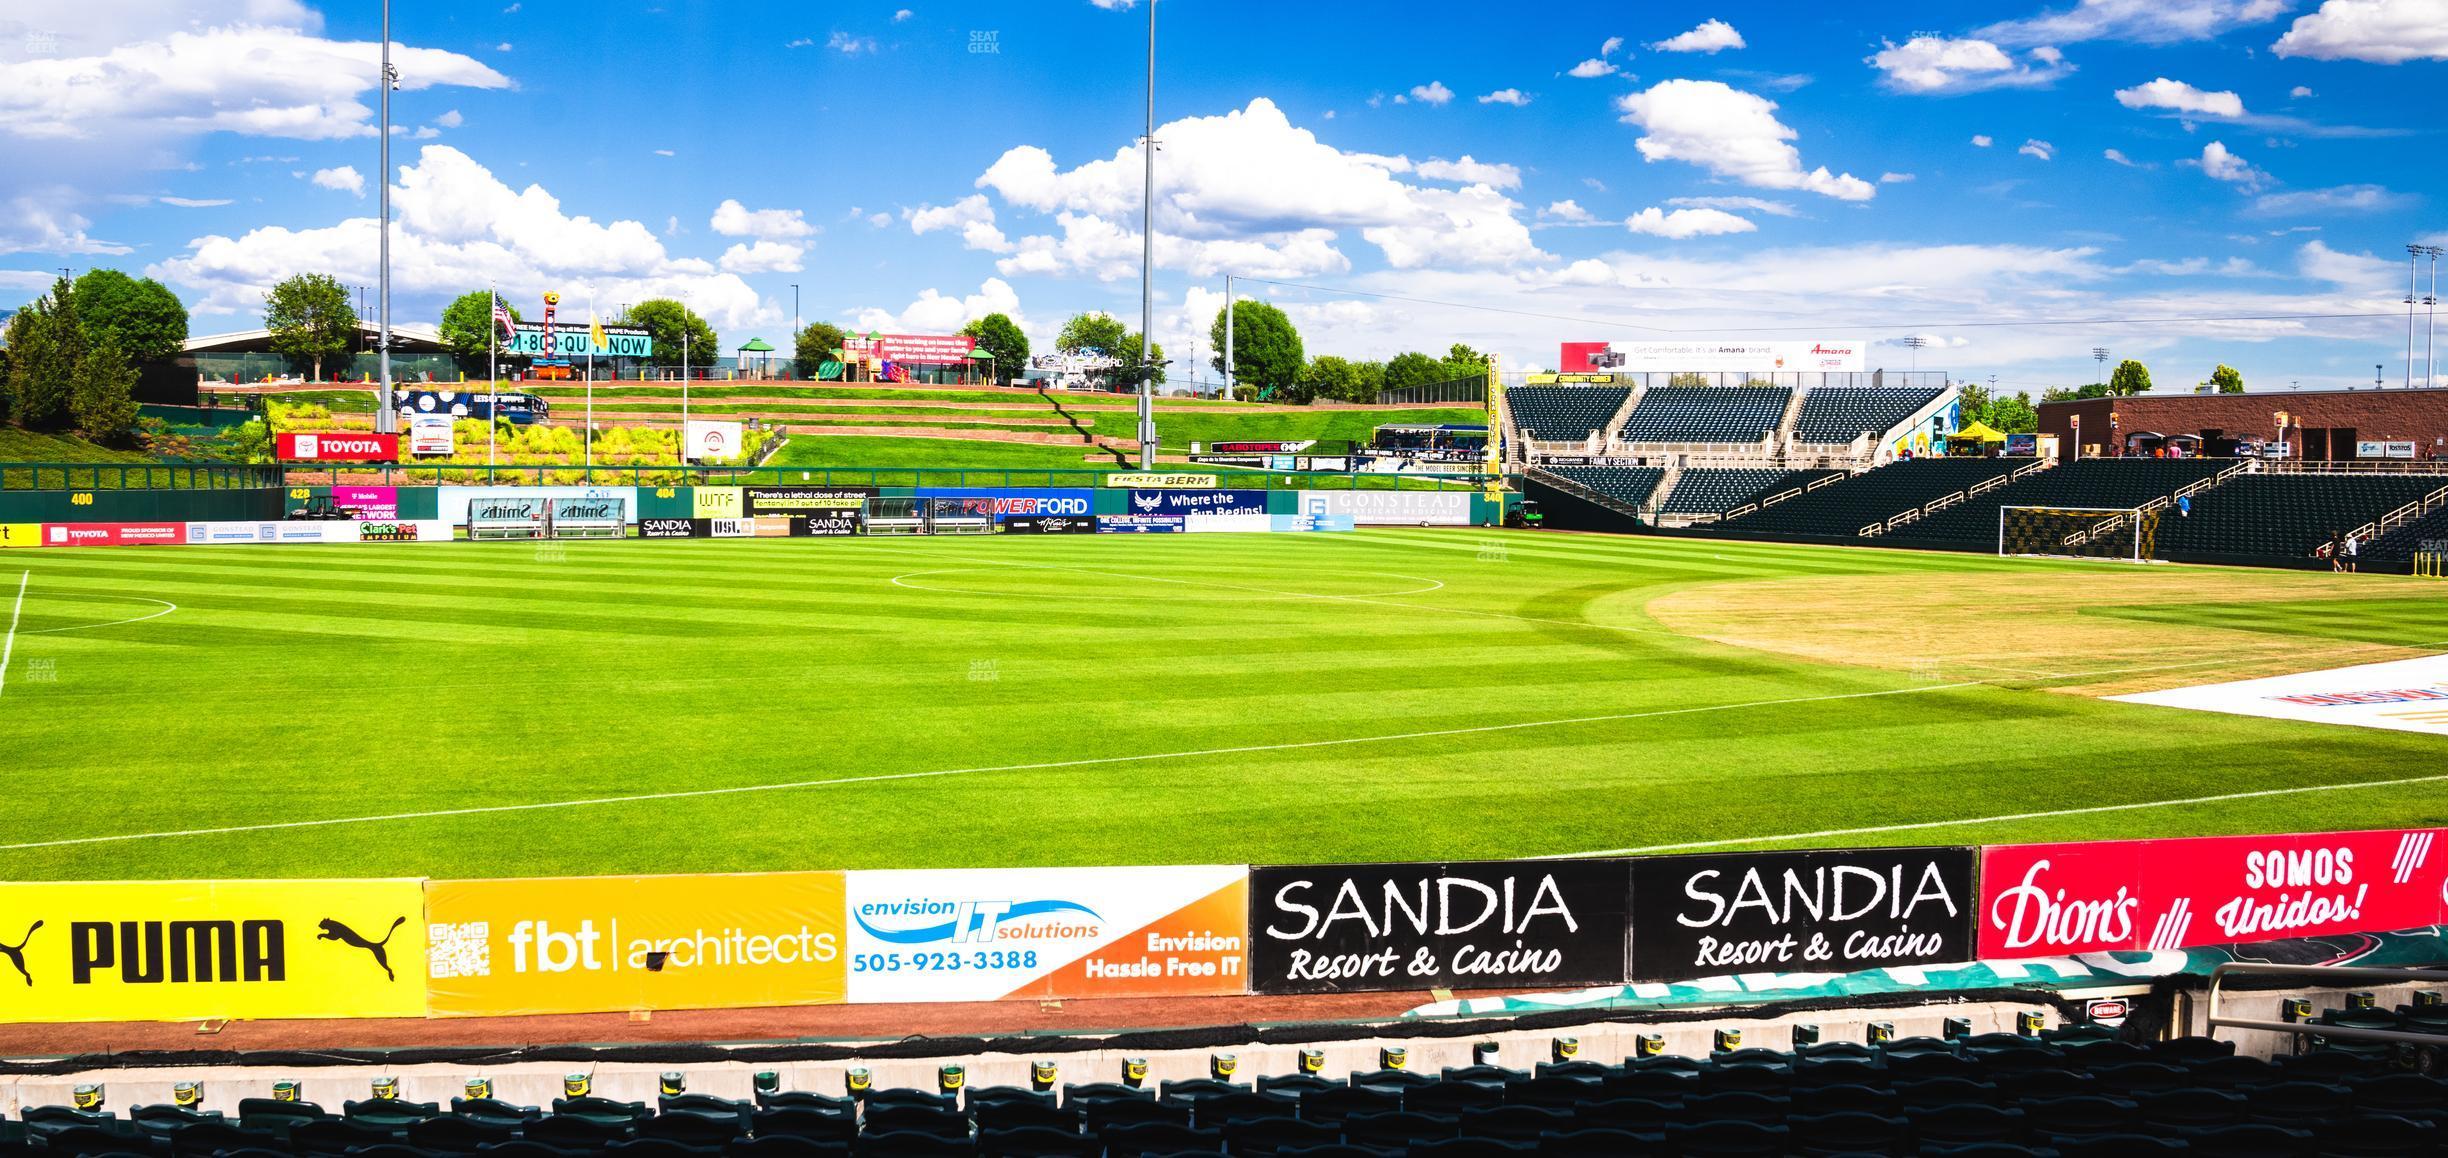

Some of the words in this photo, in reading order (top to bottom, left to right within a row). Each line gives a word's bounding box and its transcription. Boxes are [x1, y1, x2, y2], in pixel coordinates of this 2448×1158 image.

[609, 338, 646, 354] NOW
[904, 338, 928, 346] working
[1811, 344, 1852, 354] Amana
[321, 440, 382, 453] TOYOTA
[1415, 464, 1424, 472] THE
[1426, 464, 1442, 472] MODEL
[1443, 464, 1456, 472] BEER
[1457, 464, 1472, 472] SINCE
[1589, 457, 1612, 466] FAMILY
[1613, 457, 1639, 466] SECTION
[1164, 477, 1210, 485] BERM
[71, 493, 94, 505] 400
[290, 489, 311, 499] 428
[656, 488, 676, 498] 404
[700, 493, 733, 506] WTF
[1170, 494, 1210, 506] Where
[1213, 493, 1234, 504] the
[1484, 493, 1500, 502] 340
[1340, 494, 1461, 508] GONSTEAD
[1216, 505, 1263, 516] Begins!
[360, 521, 397, 534] Clark's
[399, 523, 417, 534] Pet
[643, 520, 692, 530] SANDIA
[809, 519, 853, 529] SANDIA
[70, 530, 108, 538] TOYOTA
[2245, 847, 2354, 890] SOMOS
[1676, 860, 1958, 928] SANDIA
[1266, 873, 1579, 940] SANDIA
[1991, 859, 2138, 949] Dion's
[2214, 884, 2368, 938] Unidos!
[862, 898, 955, 916] envision
[952, 900, 1012, 944] IT
[998, 920, 1098, 940] solutions
[508, 918, 600, 972] fbt
[628, 926, 836, 969] architects
[1147, 930, 1240, 952] Envision
[1694, 933, 1799, 967] Resort
[1803, 932, 1832, 961] &
[1843, 924, 1942, 960] Casino
[71, 919, 286, 984] PUMA
[854, 950, 1038, 972] 505-923-3388
[1286, 944, 1402, 981] Resort
[1408, 946, 1440, 976] &
[1452, 938, 1562, 976] Casino
[1086, 957, 1162, 978] Hassle
[1166, 956, 1216, 978] Free
[1222, 956, 1242, 976] IT
[2094, 1006, 2122, 1015] BEWARE
